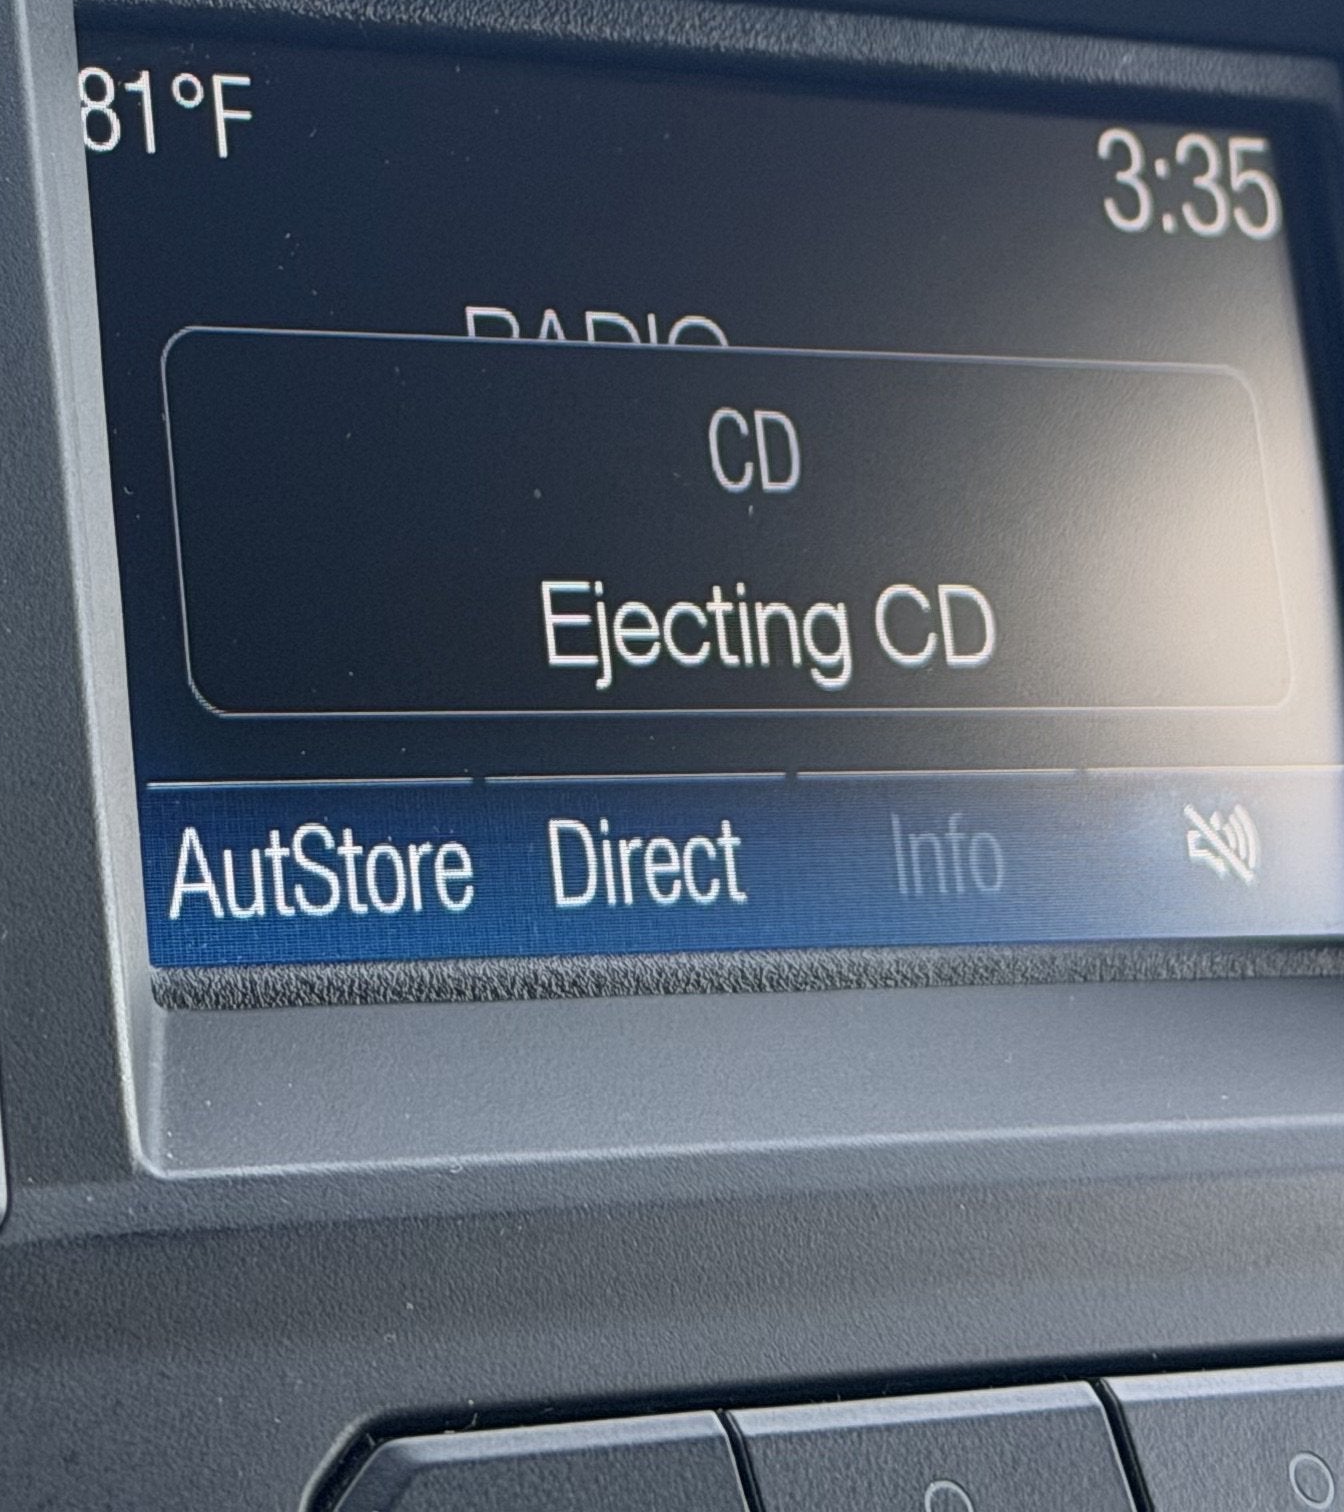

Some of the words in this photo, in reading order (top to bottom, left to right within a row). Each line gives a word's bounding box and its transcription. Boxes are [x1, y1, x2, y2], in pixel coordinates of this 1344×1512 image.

[77, 67, 253, 159] 81°F
[1097, 128, 1283, 239] 3:35
[708, 407, 801, 493] CD
[540, 579, 850, 690] Ejecting
[875, 584, 997, 669] CD
[167, 821, 475, 922] AutStore
[548, 817, 748, 908] Direct
[890, 811, 1006, 902] Info
